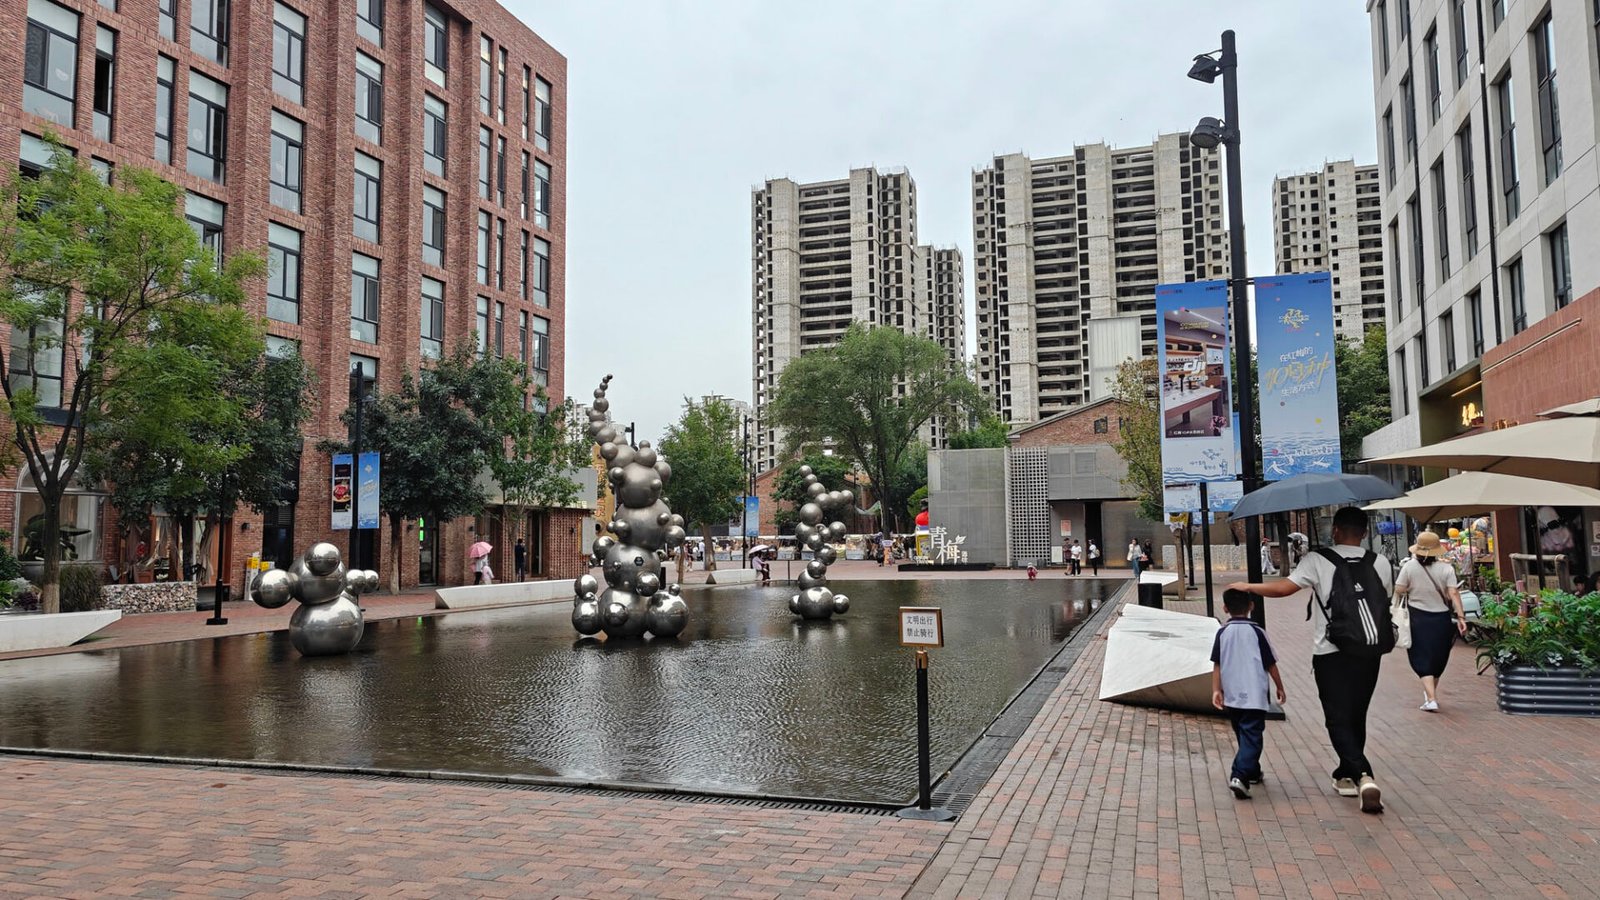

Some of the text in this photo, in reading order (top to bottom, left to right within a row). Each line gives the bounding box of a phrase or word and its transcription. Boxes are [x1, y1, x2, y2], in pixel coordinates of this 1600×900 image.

[906, 615, 934, 625] 文明出行
[906, 628, 934, 638] 禁止骑行
